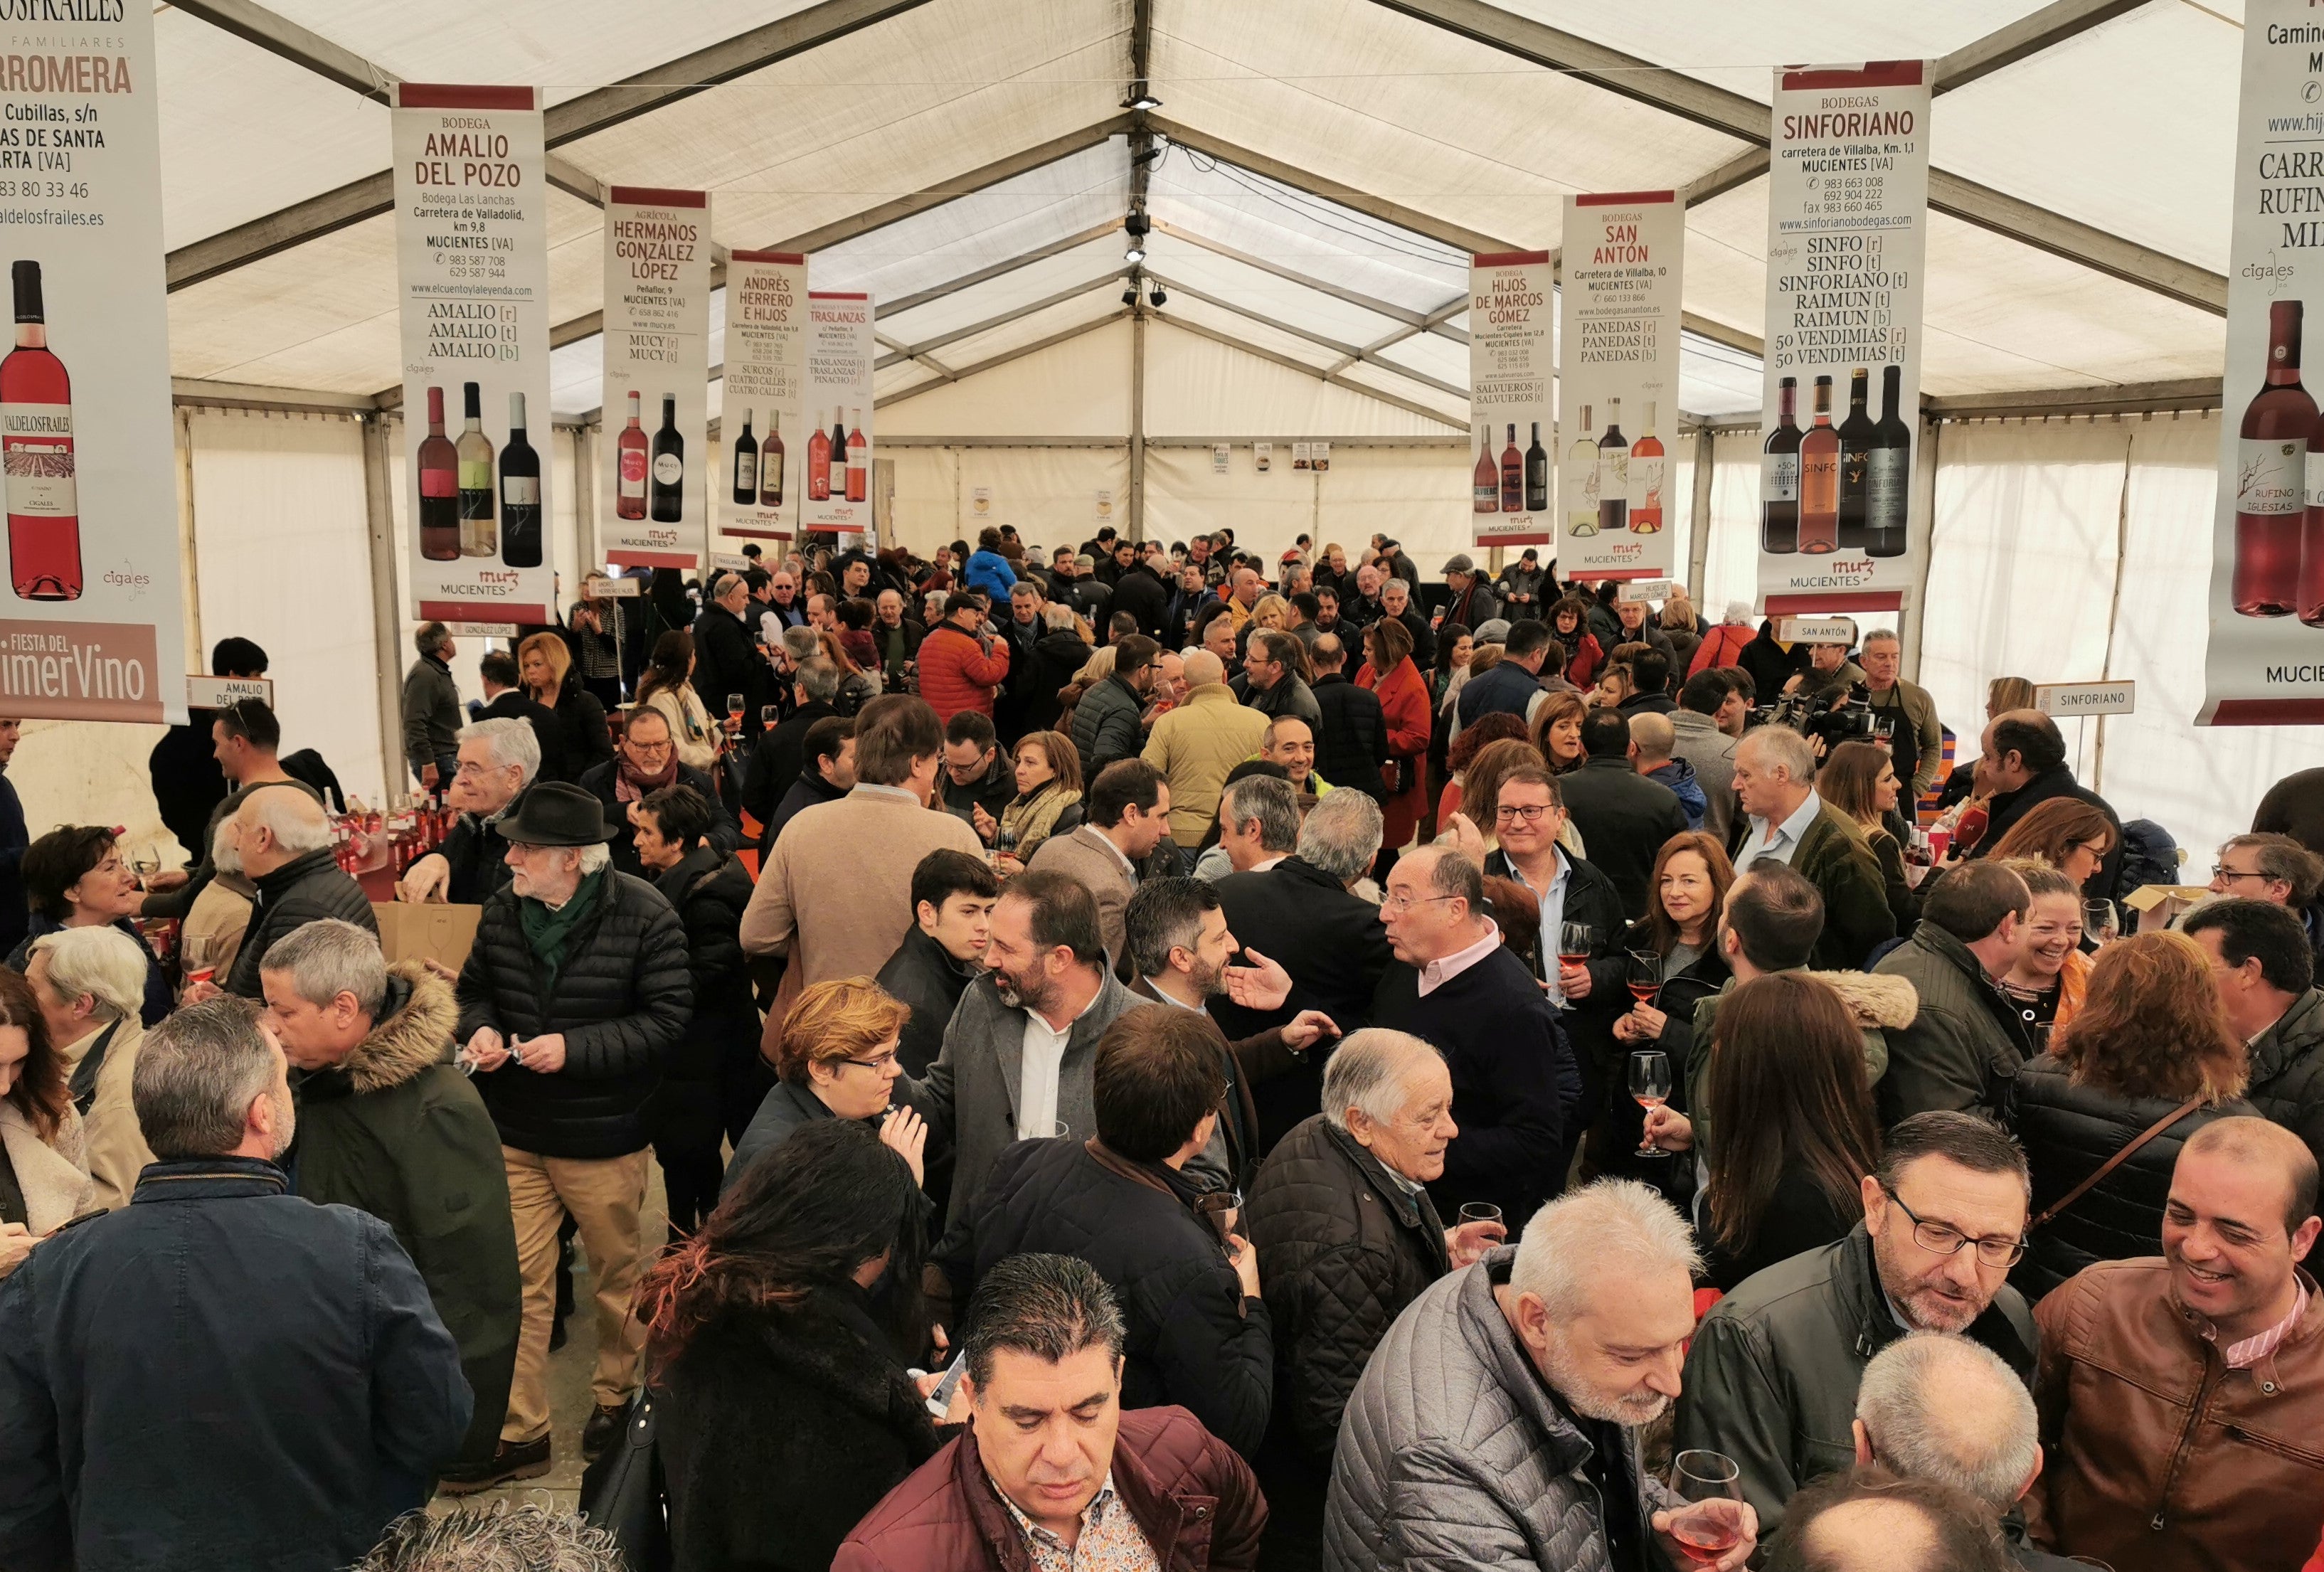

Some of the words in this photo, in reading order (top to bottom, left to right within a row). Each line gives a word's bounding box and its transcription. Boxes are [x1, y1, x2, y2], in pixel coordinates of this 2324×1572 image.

[11, 36, 124, 48] FAMILIARES
[1821, 96, 1878, 109] BODEGAS
[6, 104, 69, 124] Cubillas,
[75, 103, 97, 122] s/n
[441, 117, 490, 129] BODEGA
[1783, 111, 1914, 139] SINFORIANO
[26, 129, 46, 147] DE
[53, 130, 105, 148] SANTA
[425, 134, 508, 159] AMALIO
[1782, 148, 1825, 158] carretera
[1830, 146, 1840, 156] de
[1844, 144, 1880, 156] Villalba,
[1884, 144, 1901, 154] Km.
[1904, 143, 1914, 154] 1,1
[38, 152, 70, 171] [VA]
[1802, 159, 1867, 173] MUCIENTES
[1871, 158, 1893, 171] [VA]
[415, 161, 455, 186] DEL
[465, 164, 520, 187] POZO
[1825, 179, 1842, 188] 983
[1845, 178, 1862, 187] 663
[1866, 177, 1883, 186] 008
[22, 181, 40, 197] 80
[46, 182, 64, 197] 33
[70, 182, 88, 198] 46
[1825, 191, 1841, 201] 692
[1845, 190, 1862, 199] 904
[1866, 189, 1882, 198] 222
[423, 193, 455, 206] Bodega
[460, 193, 474, 204] Las
[477, 194, 514, 206] Lanchas
[1804, 202, 1820, 213] fax
[1824, 203, 1841, 213] 983
[1845, 202, 1862, 211] 660
[1864, 201, 1882, 211] 465
[414, 207, 458, 218] Carretera
[462, 208, 473, 218] de
[477, 208, 524, 221] Valladolid,
[635, 211, 676, 221] AGRÍCOLA
[1602, 213, 1642, 223] BODEGAS
[454, 222, 467, 232] km
[471, 222, 485, 233] 9,8
[1780, 216, 1911, 230] www.sinforianobodegas.com
[614, 221, 696, 242] HERMANOS
[1606, 225, 1637, 243] SAN
[427, 236, 488, 248] MUCIENTES
[492, 237, 513, 250] [VA]
[617, 235, 694, 261] GONZÁLEZ
[1807, 236, 1862, 253] SINFO
[1867, 236, 1882, 253] [r]
[1593, 241, 1648, 264] ANTÓN
[450, 255, 466, 265] 983
[469, 256, 486, 266] 587
[489, 256, 505, 266] 708
[1807, 255, 1862, 272] SINFO
[1867, 255, 1880, 272] [t]
[450, 267, 466, 277] 629
[469, 268, 486, 277] 587
[488, 269, 505, 278] 944
[632, 259, 677, 280] LÓPEZ
[1575, 270, 1611, 279] Carretera
[1614, 269, 1623, 277] de
[1626, 268, 1655, 277] Villalba,
[1658, 267, 1665, 276] 10
[744, 274, 789, 292] ANDRÉS
[1492, 279, 1527, 292] HIJOS
[1588, 281, 1633, 290] MUCIENTES
[1636, 280, 1652, 290] [VA]
[1779, 272, 1888, 292] SINFORIANO
[1893, 272, 1907, 289] [t]
[411, 284, 531, 296] www.elcuentoylaleyenda.com
[637, 285, 666, 294] Peñaflor,
[625, 295, 667, 305] MUCIENTES
[740, 292, 792, 307] HERRERO
[1476, 296, 1490, 309] DE
[1495, 293, 1543, 308] MARCOS
[1795, 292, 1872, 309] RAIMUN
[1876, 292, 1889, 308] [t]
[428, 304, 495, 319] AMALIO
[500, 306, 516, 322] [r]
[745, 307, 750, 319] E
[755, 309, 787, 322] HIJOS
[811, 312, 865, 323] TRASLANZAS
[1490, 304, 1530, 323] GÓMEZ
[1578, 306, 1660, 316] www.bodegasananton.es
[1793, 310, 1869, 327] RAIMUN
[1874, 310, 1891, 326] [b]
[428, 324, 496, 339] AMALIO
[502, 326, 516, 341] [t]
[1582, 321, 1640, 334] PANEDAS
[630, 335, 665, 346] MUCY
[1583, 336, 1640, 348] PANEDAS
[1776, 334, 1793, 350] 50
[1798, 327, 1887, 346] VENDIMIAS
[1891, 327, 1906, 344] [r]
[428, 343, 495, 359] AMALIO
[500, 345, 519, 361] [b]
[630, 349, 664, 360] MUCY
[1581, 350, 1639, 362] PANEDAS
[1776, 354, 1793, 368] 50
[1798, 346, 1886, 364] VENDIMIAS
[1890, 346, 1904, 362] [t]
[742, 366, 773, 375] SURCOS
[729, 375, 758, 384] CUATRO
[760, 377, 785, 386] CALLES
[729, 385, 758, 395] CUATRO
[760, 388, 785, 396] CALLES
[1477, 383, 1532, 393] SALVUEROS
[1477, 393, 1532, 403] SALVUEROS
[4, 415, 70, 432] VALDELOSFRAILES
[2256, 489, 2293, 498] RUFINO
[2248, 502, 2292, 511] IGLESIAS
[622, 538, 667, 547] MUCIENTES
[1790, 576, 1859, 588] MUCIENTES
[441, 585, 505, 595] MUCIENTES
[1820, 626, 1846, 636] ANTÓN
[11, 634, 46, 652] FIESTA
[49, 635, 68, 652] DEL
[226, 684, 262, 694] AMALIO
[217, 694, 233, 704] DEL
[2062, 693, 2124, 706] SINFORIANO
